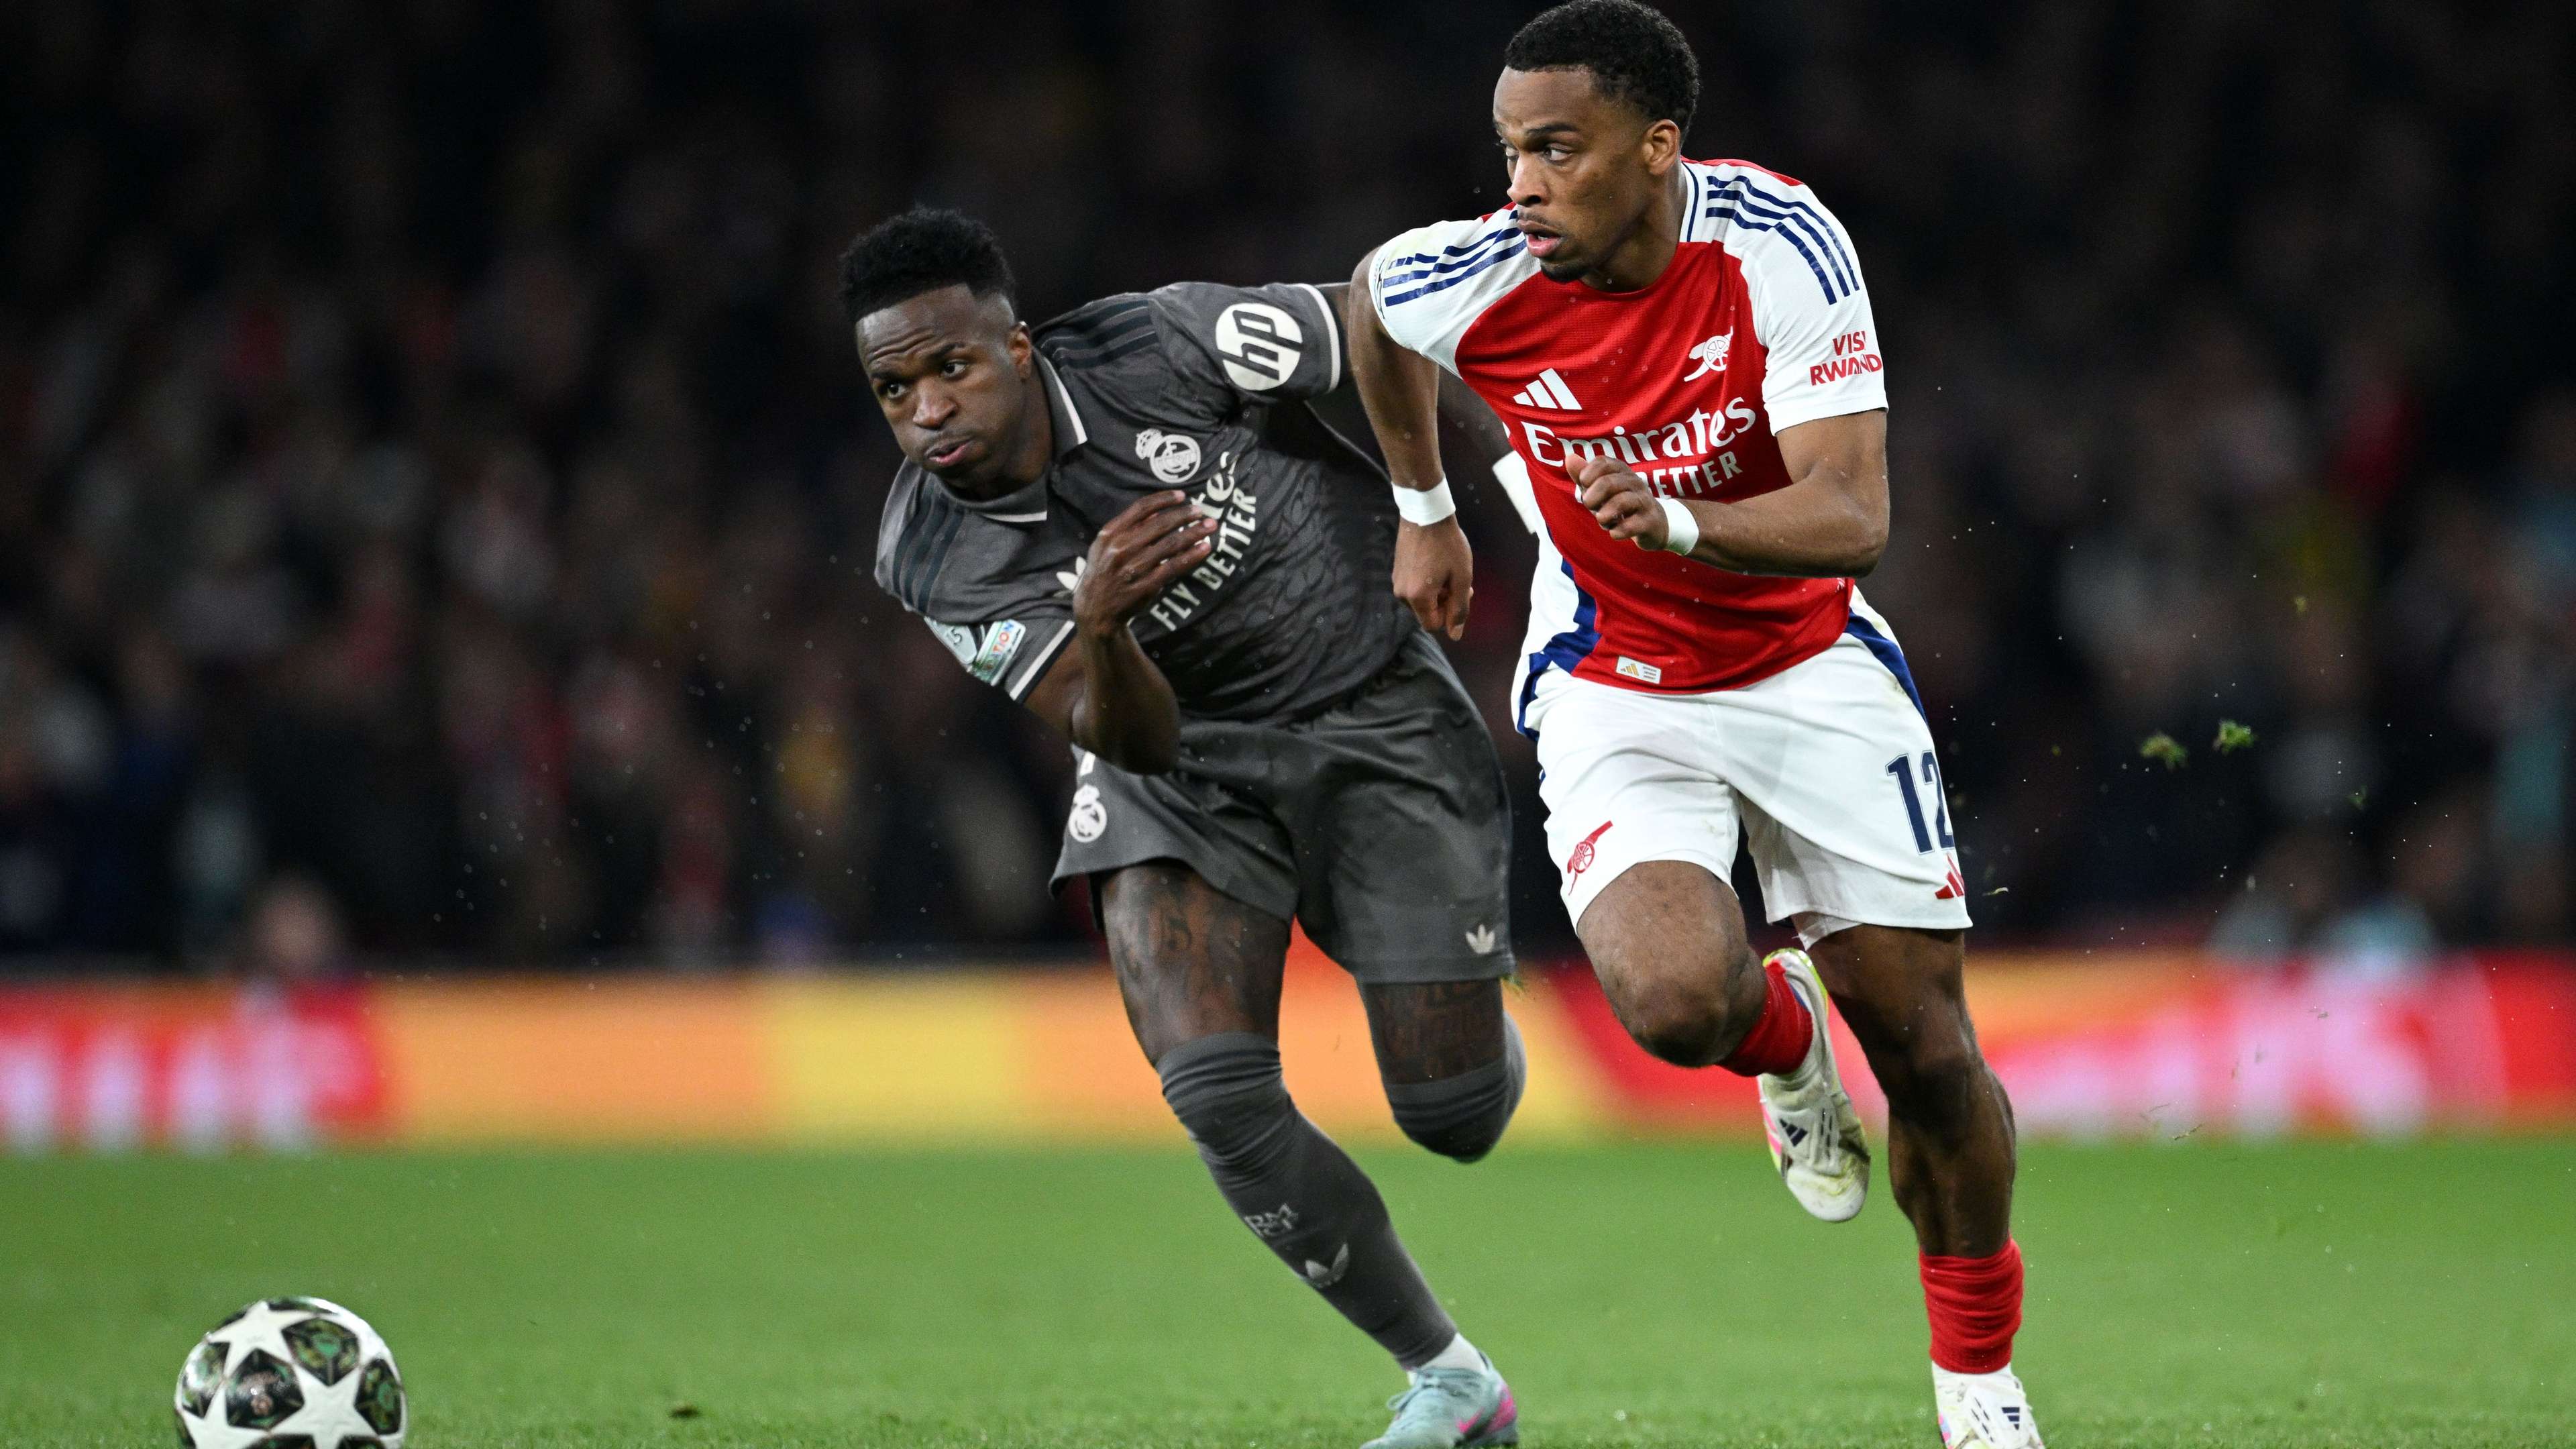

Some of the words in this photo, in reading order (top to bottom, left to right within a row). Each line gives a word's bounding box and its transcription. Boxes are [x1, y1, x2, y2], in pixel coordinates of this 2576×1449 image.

[1217, 310, 1303, 381] hp
[1520, 396, 1756, 467] Emirates
[1149, 581, 1201, 632] FLY
[1192, 486, 1256, 591] BETTER
[1886, 749, 1955, 855] 12
